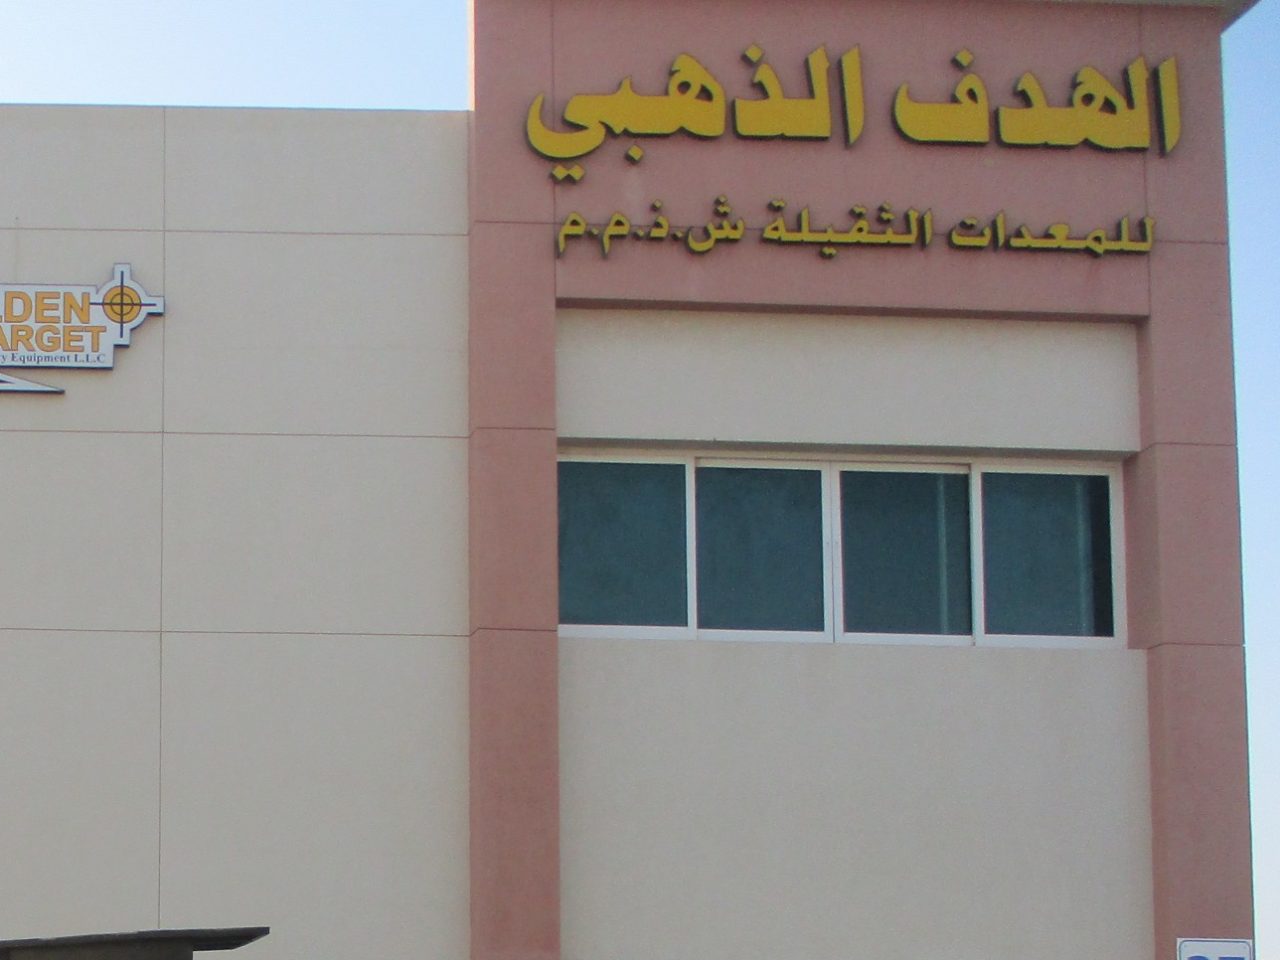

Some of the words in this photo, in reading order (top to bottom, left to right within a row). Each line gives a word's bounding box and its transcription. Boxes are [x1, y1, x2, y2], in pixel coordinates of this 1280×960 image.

[525, 42, 866, 183] الذهبي
[892, 47, 1183, 157] الهدف
[761, 198, 934, 258] الثقيلة
[950, 209, 1156, 256] للمعدات
[11, 352, 70, 365] Equipment
